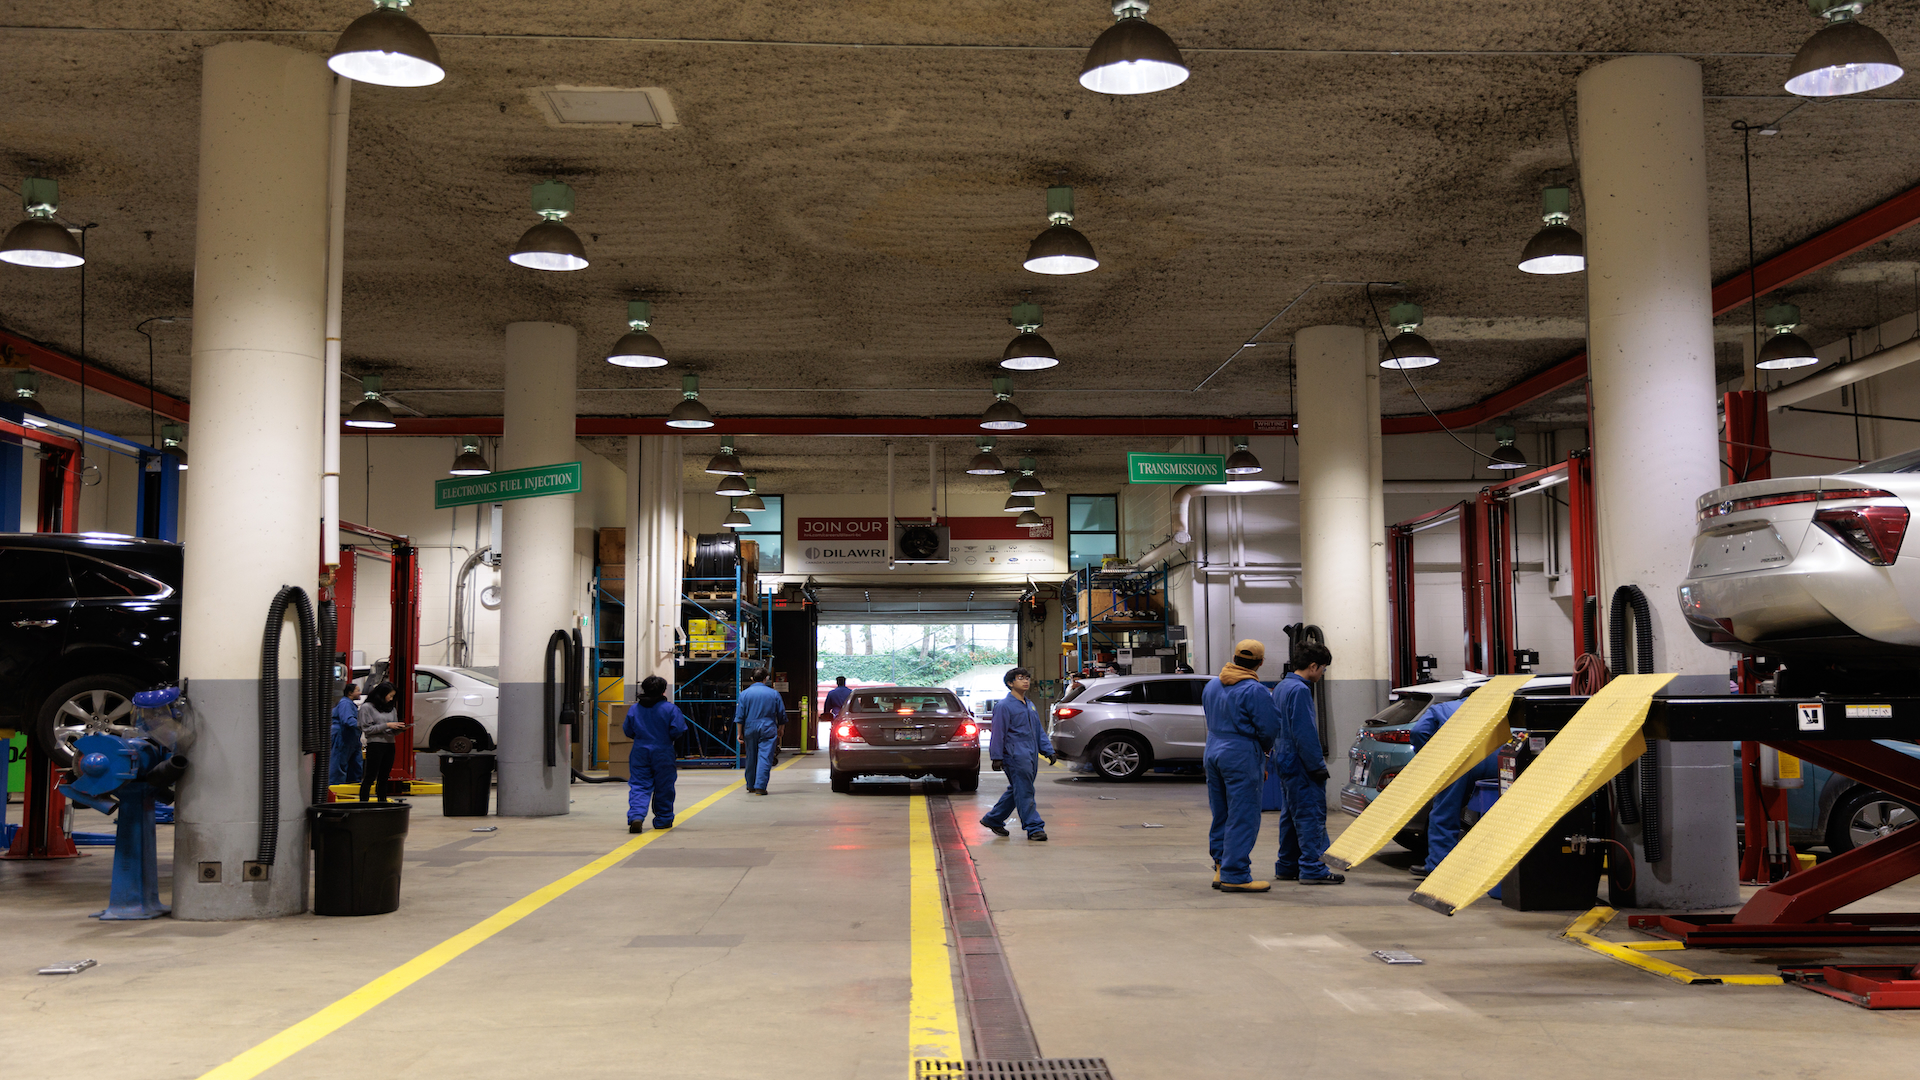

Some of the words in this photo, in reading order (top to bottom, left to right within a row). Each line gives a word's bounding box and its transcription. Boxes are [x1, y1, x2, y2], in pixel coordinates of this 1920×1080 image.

[1137, 462, 1218, 476] TRANSMISSIONS
[442, 482, 498, 499] ELECTRONICS
[500, 479, 522, 492] FUEL
[524, 472, 573, 491] INJECTION
[803, 521, 842, 533] JOIN
[846, 521, 882, 533] OUR
[823, 549, 885, 558] DILAWRI
